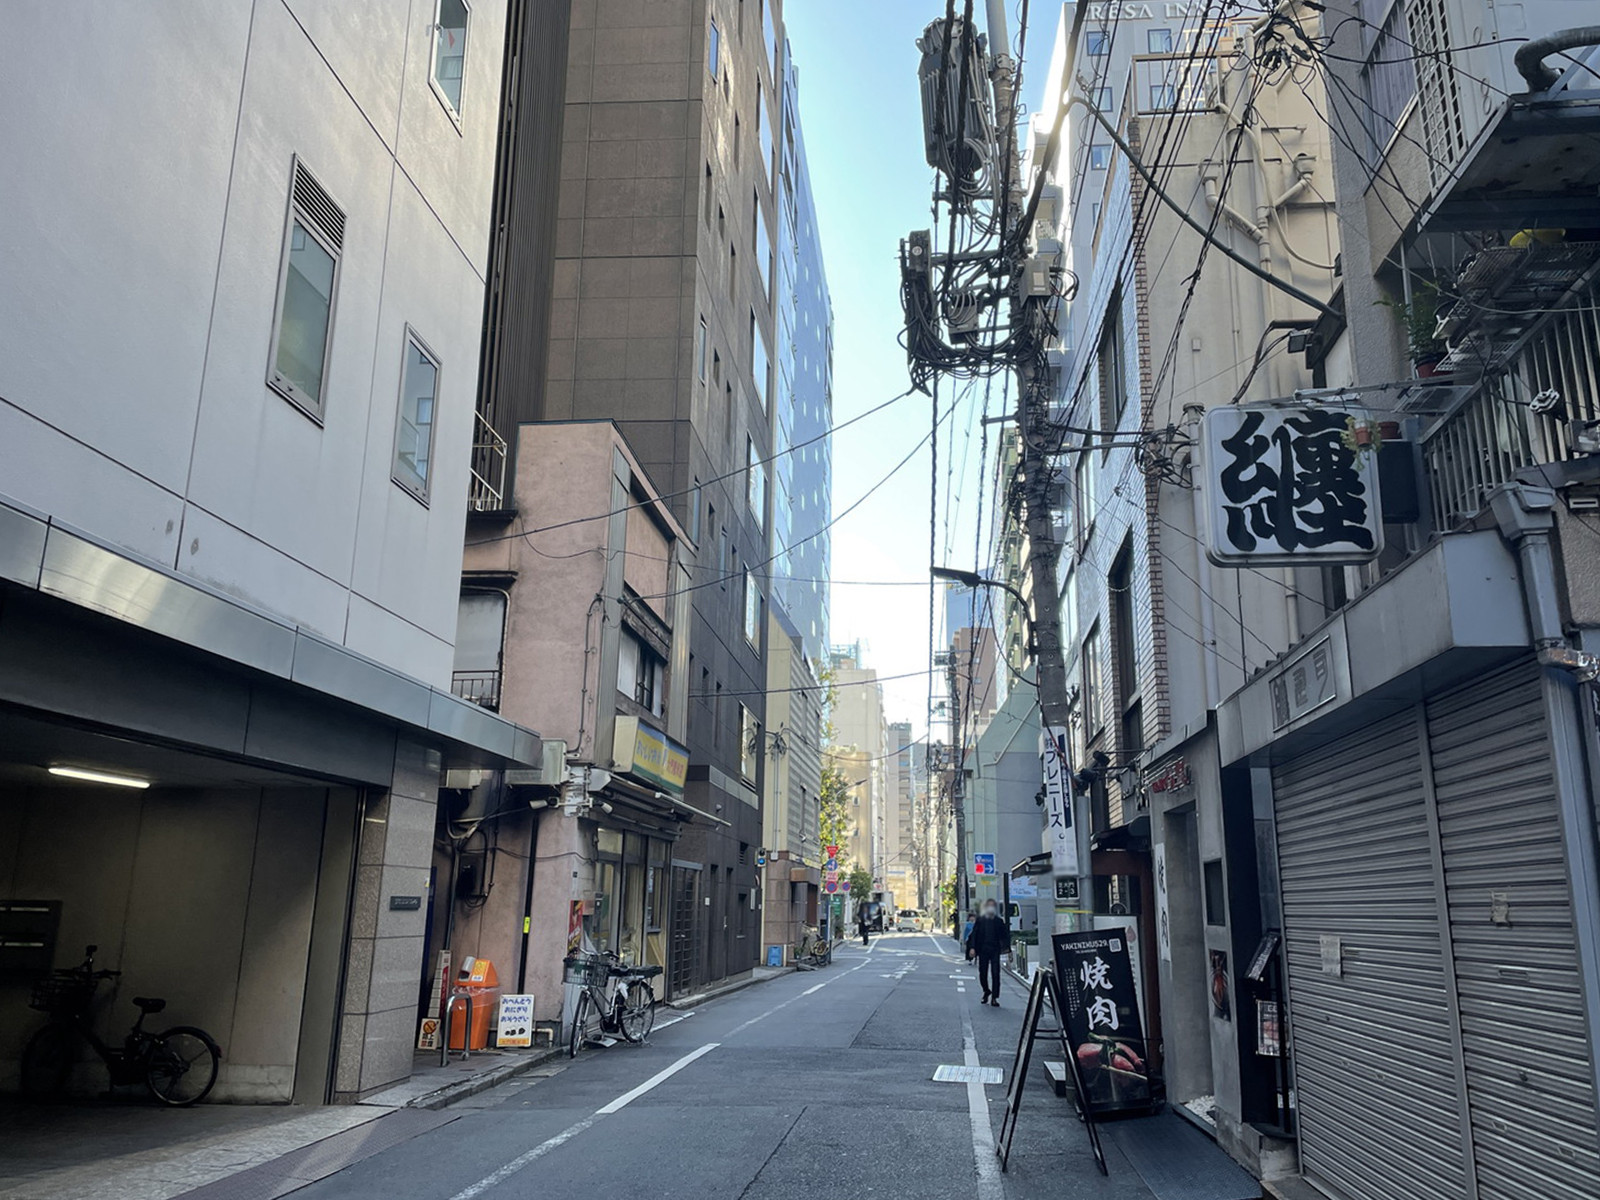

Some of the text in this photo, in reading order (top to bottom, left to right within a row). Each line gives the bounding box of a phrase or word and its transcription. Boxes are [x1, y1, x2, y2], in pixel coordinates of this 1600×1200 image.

[1073, 3, 1211, 20] RESA INN
[1080, 956, 1119, 1030] 焼肉
